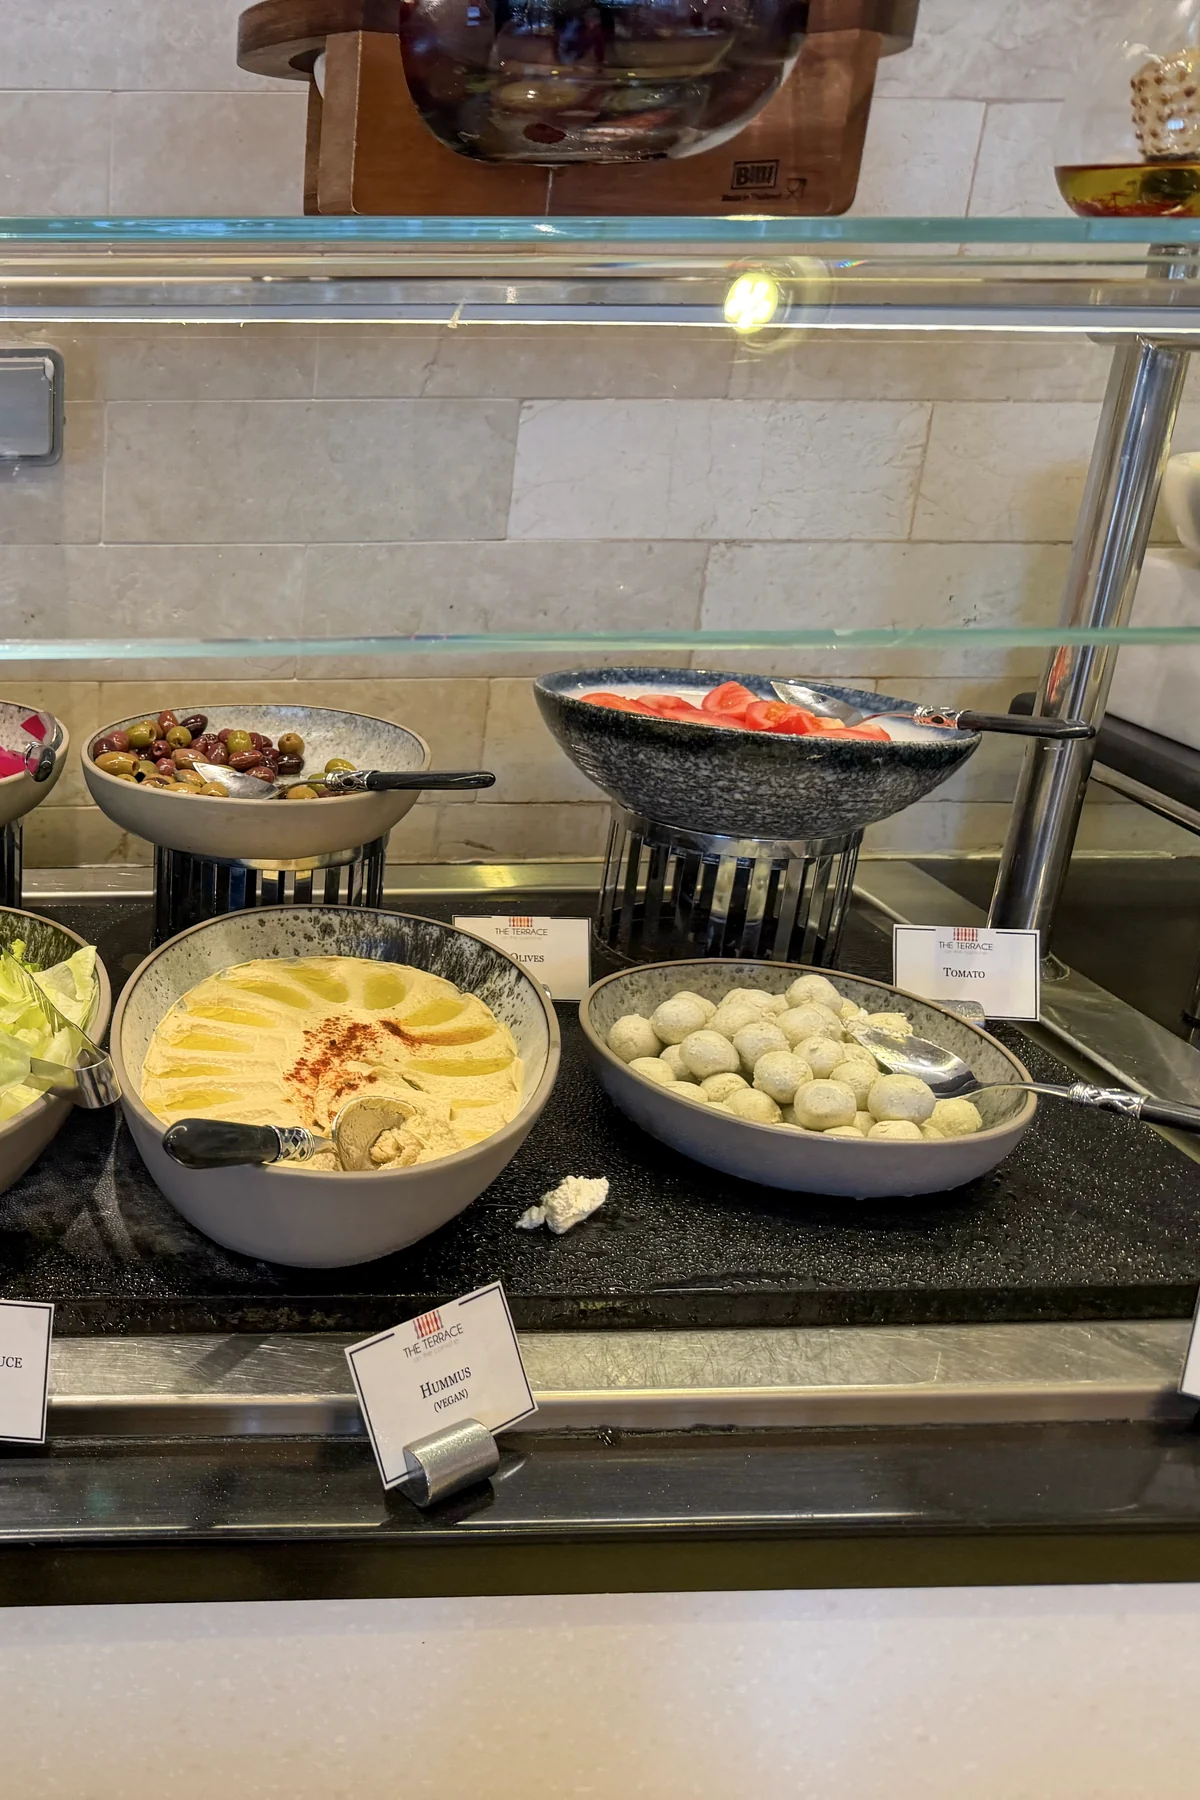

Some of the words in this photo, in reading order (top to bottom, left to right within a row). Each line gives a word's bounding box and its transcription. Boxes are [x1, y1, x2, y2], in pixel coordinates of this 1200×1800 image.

[494, 927, 510, 935] THE
[511, 928, 548, 936] TERRACE
[938, 941, 954, 949] THE
[956, 941, 993, 951] TERRACE
[943, 967, 986, 979] TOMATO
[403, 1342, 421, 1358] THE
[421, 1323, 464, 1350] TERRACE
[419, 1366, 472, 1399] HUMMUS
[433, 1388, 469, 1413] (VEGAN)
